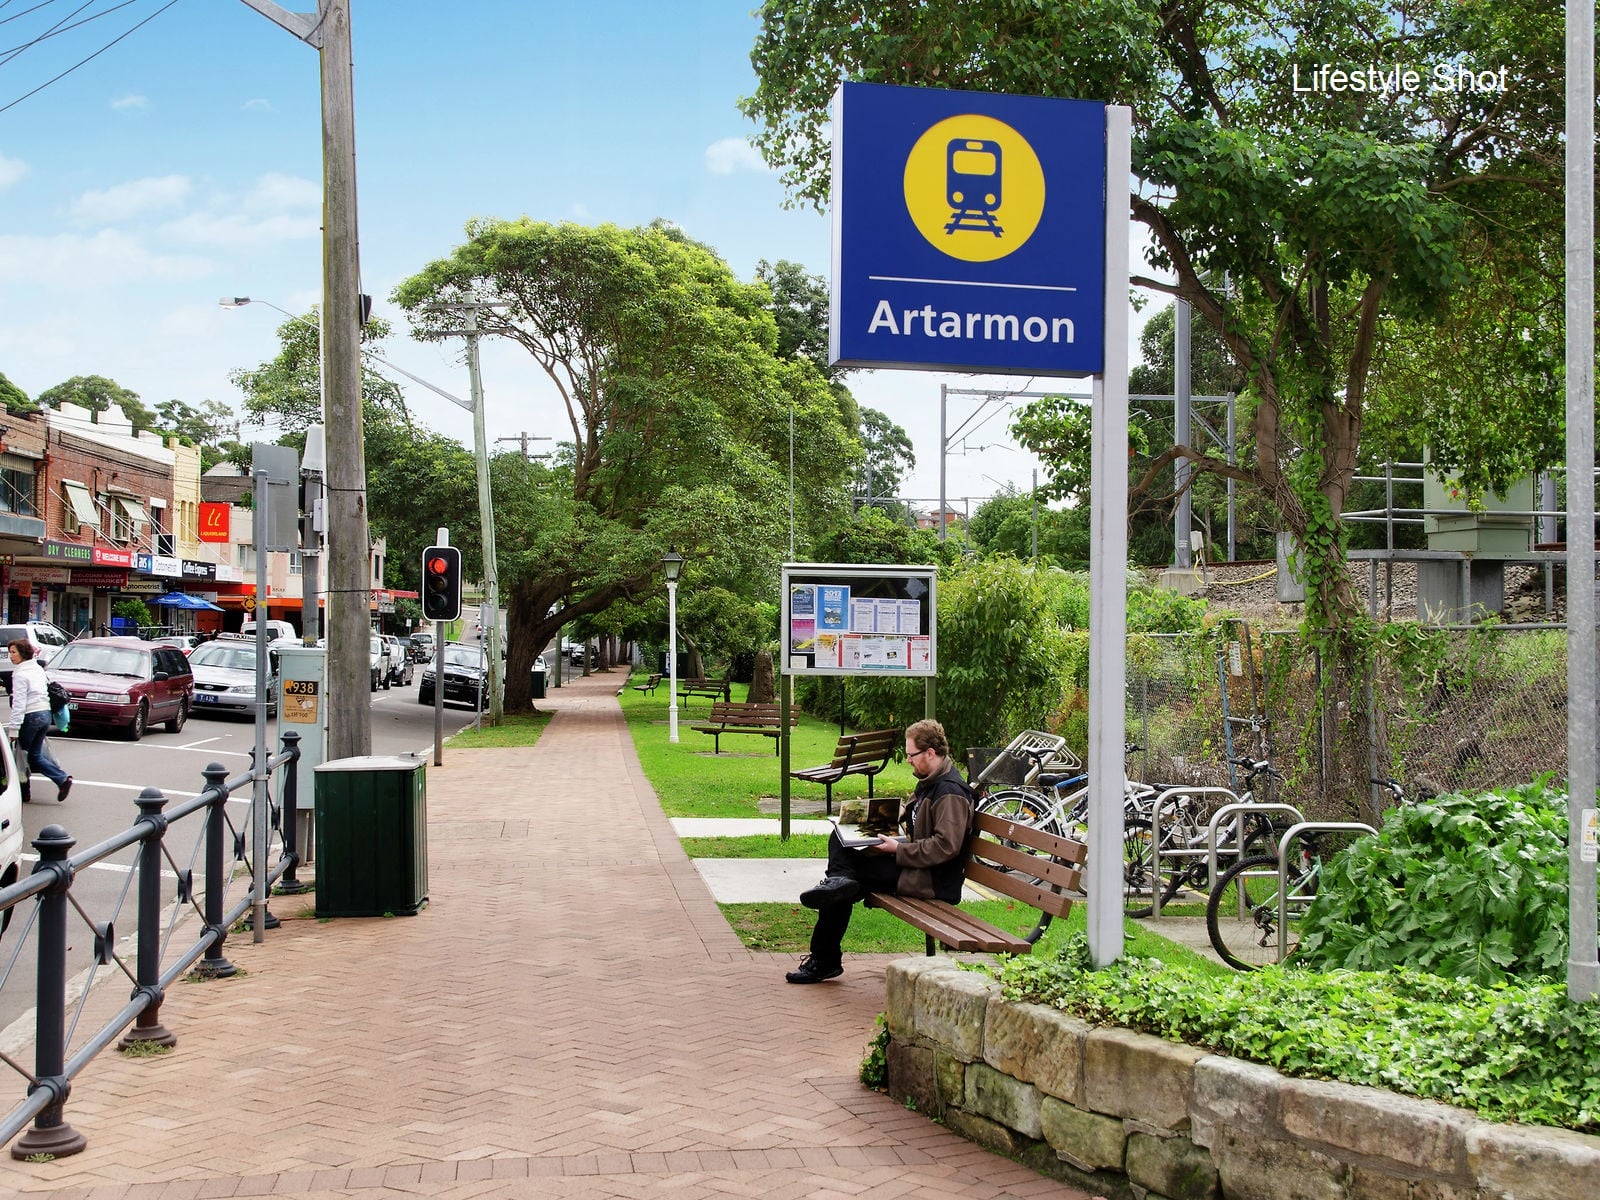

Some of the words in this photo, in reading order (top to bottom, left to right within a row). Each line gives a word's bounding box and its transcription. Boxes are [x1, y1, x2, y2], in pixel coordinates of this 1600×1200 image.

[867, 300, 1075, 344] Artarmon
[48, 545, 59, 555] DRY
[64, 547, 90, 559] CLEANERS
